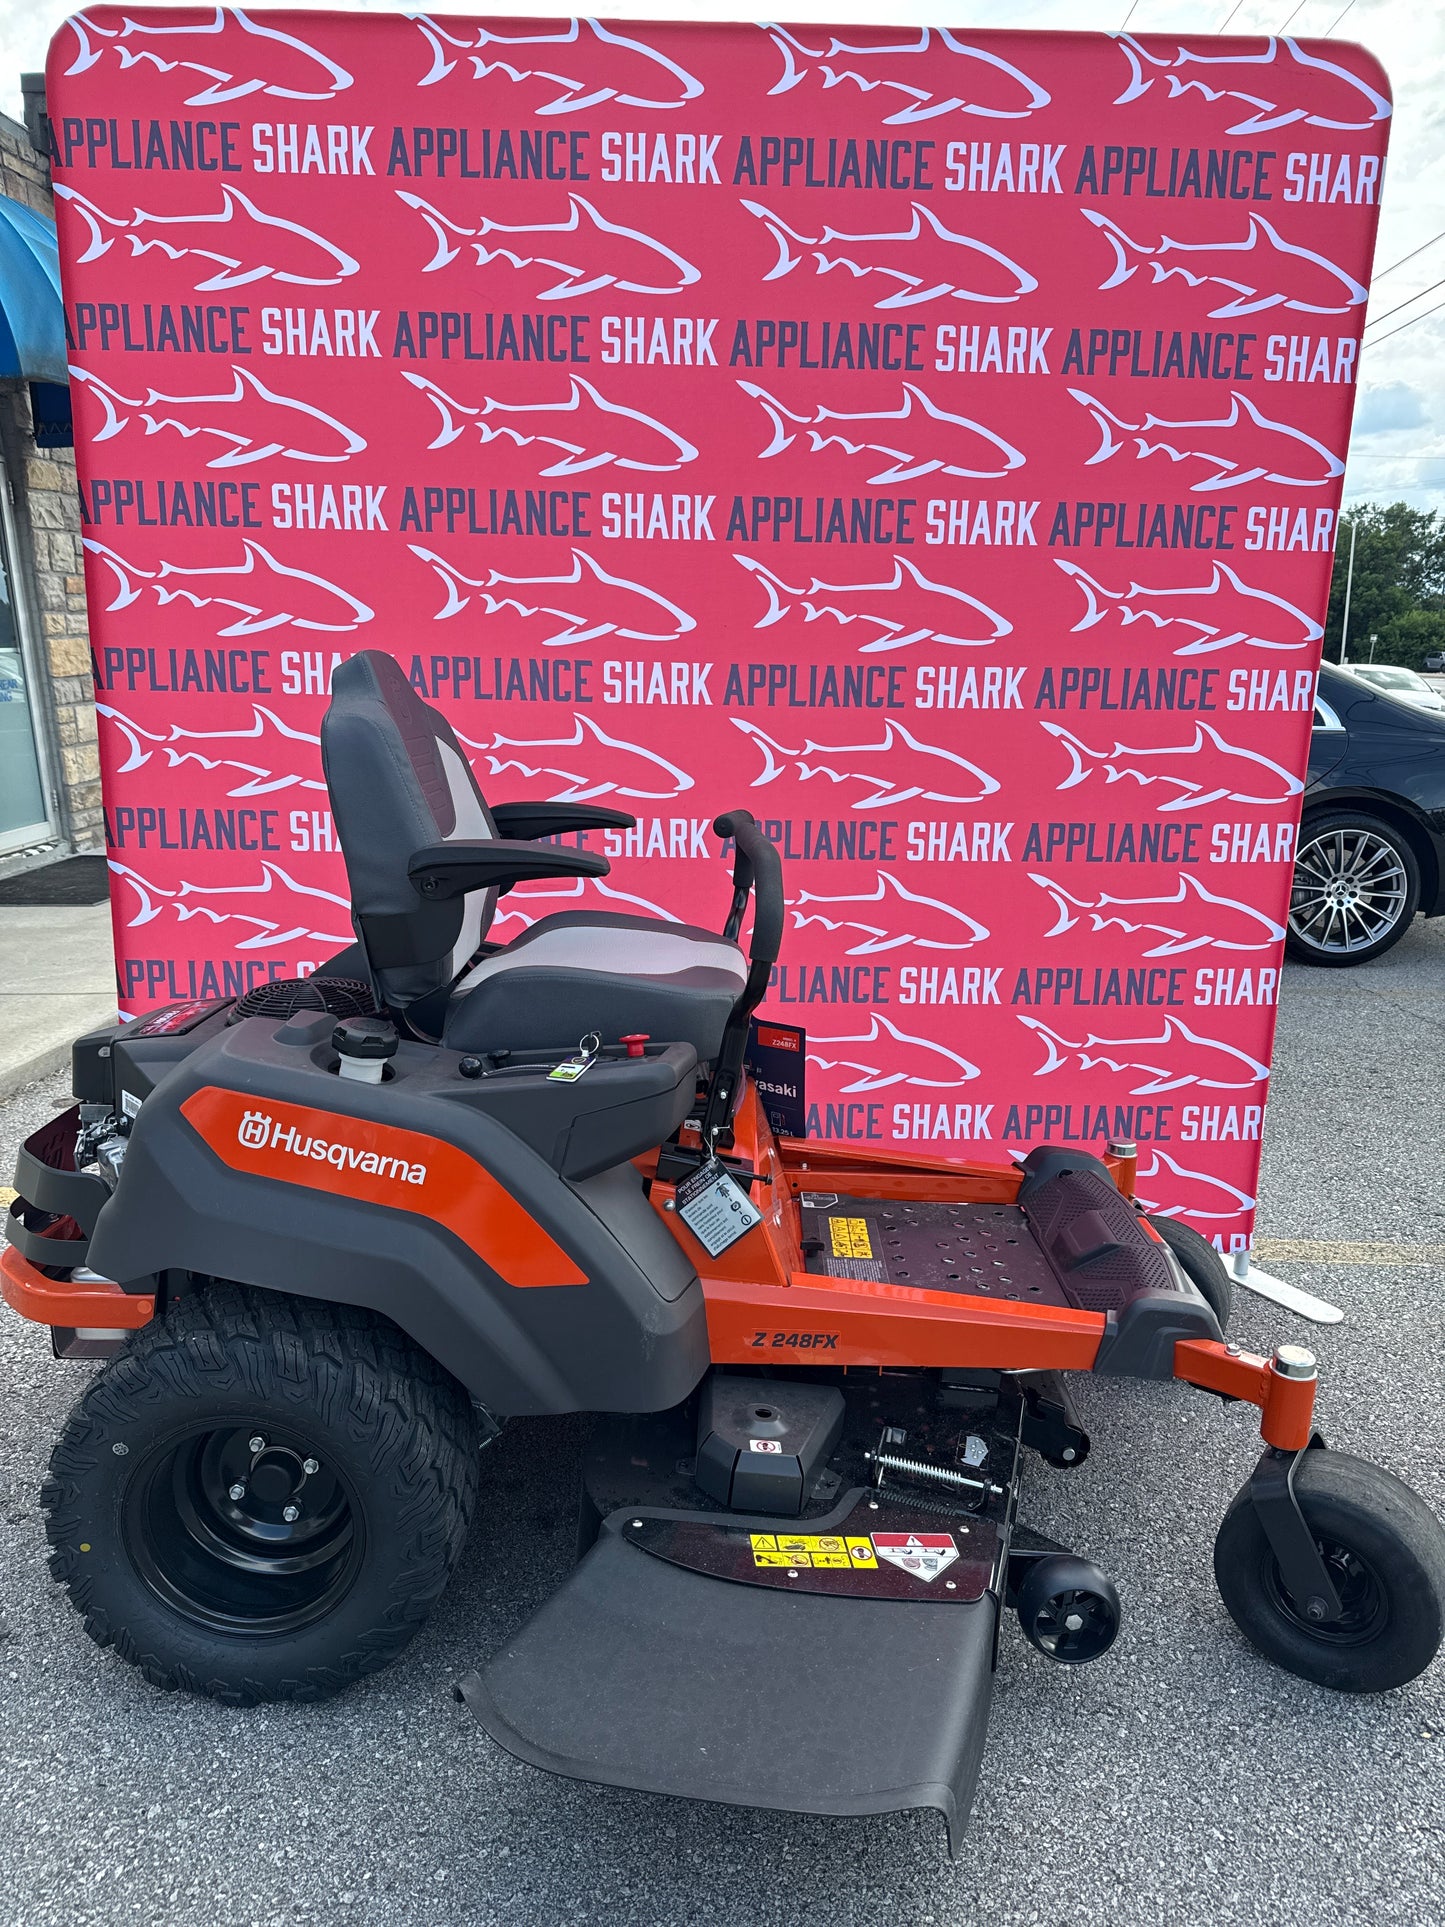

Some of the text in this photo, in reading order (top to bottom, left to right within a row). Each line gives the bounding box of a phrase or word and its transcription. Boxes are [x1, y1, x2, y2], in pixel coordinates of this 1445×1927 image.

[53, 117, 242, 172] APPLIANCE
[253, 124, 375, 175] SHARK
[388, 128, 589, 180] APPLIANCE
[602, 132, 721, 184] SHARK
[734, 137, 934, 189] APPLIANCE
[946, 142, 1066, 193] SHARK
[1076, 146, 1276, 200] APPLIANCE
[262, 308, 381, 357] SHARK
[394, 312, 589, 362] APPLIANCE
[602, 317, 718, 365] SHARK
[730, 320, 925, 370] APPLIANCE
[936, 325, 1052, 374] SHARK
[1063, 329, 1256, 379] APPLIANCE
[272, 484, 388, 530] SHARK
[401, 488, 590, 536] APPLIANCE
[603, 493, 715, 540] SHARK
[727, 497, 915, 543] APPLIANCE
[926, 500, 1039, 545] SHARK
[1050, 503, 1237, 549] APPLIANCE
[408, 656, 592, 704] APPLIANCE
[604, 661, 712, 705] SHARK
[724, 665, 905, 707] APPLIANCE
[916, 667, 1026, 708] SHARK
[1036, 668, 1218, 710] APPLIANCE
[605, 818, 710, 858] SHARK
[720, 819, 898, 861] PLIANCE
[907, 822, 1014, 861] SHARK
[1023, 824, 1201, 862] APPLIANCE
[900, 967, 1003, 1004] SHARK
[1013, 969, 1186, 1004] APPLIANCE
[772, 1039, 797, 1050] Z248FX
[893, 1104, 993, 1139] SHARK
[1004, 1106, 1172, 1140] APPLIANCE
[270, 1123, 427, 1185] Husqvarna
[677, 1180, 692, 1194] POUR
[751, 1332, 839, 1349] Z 248FX
